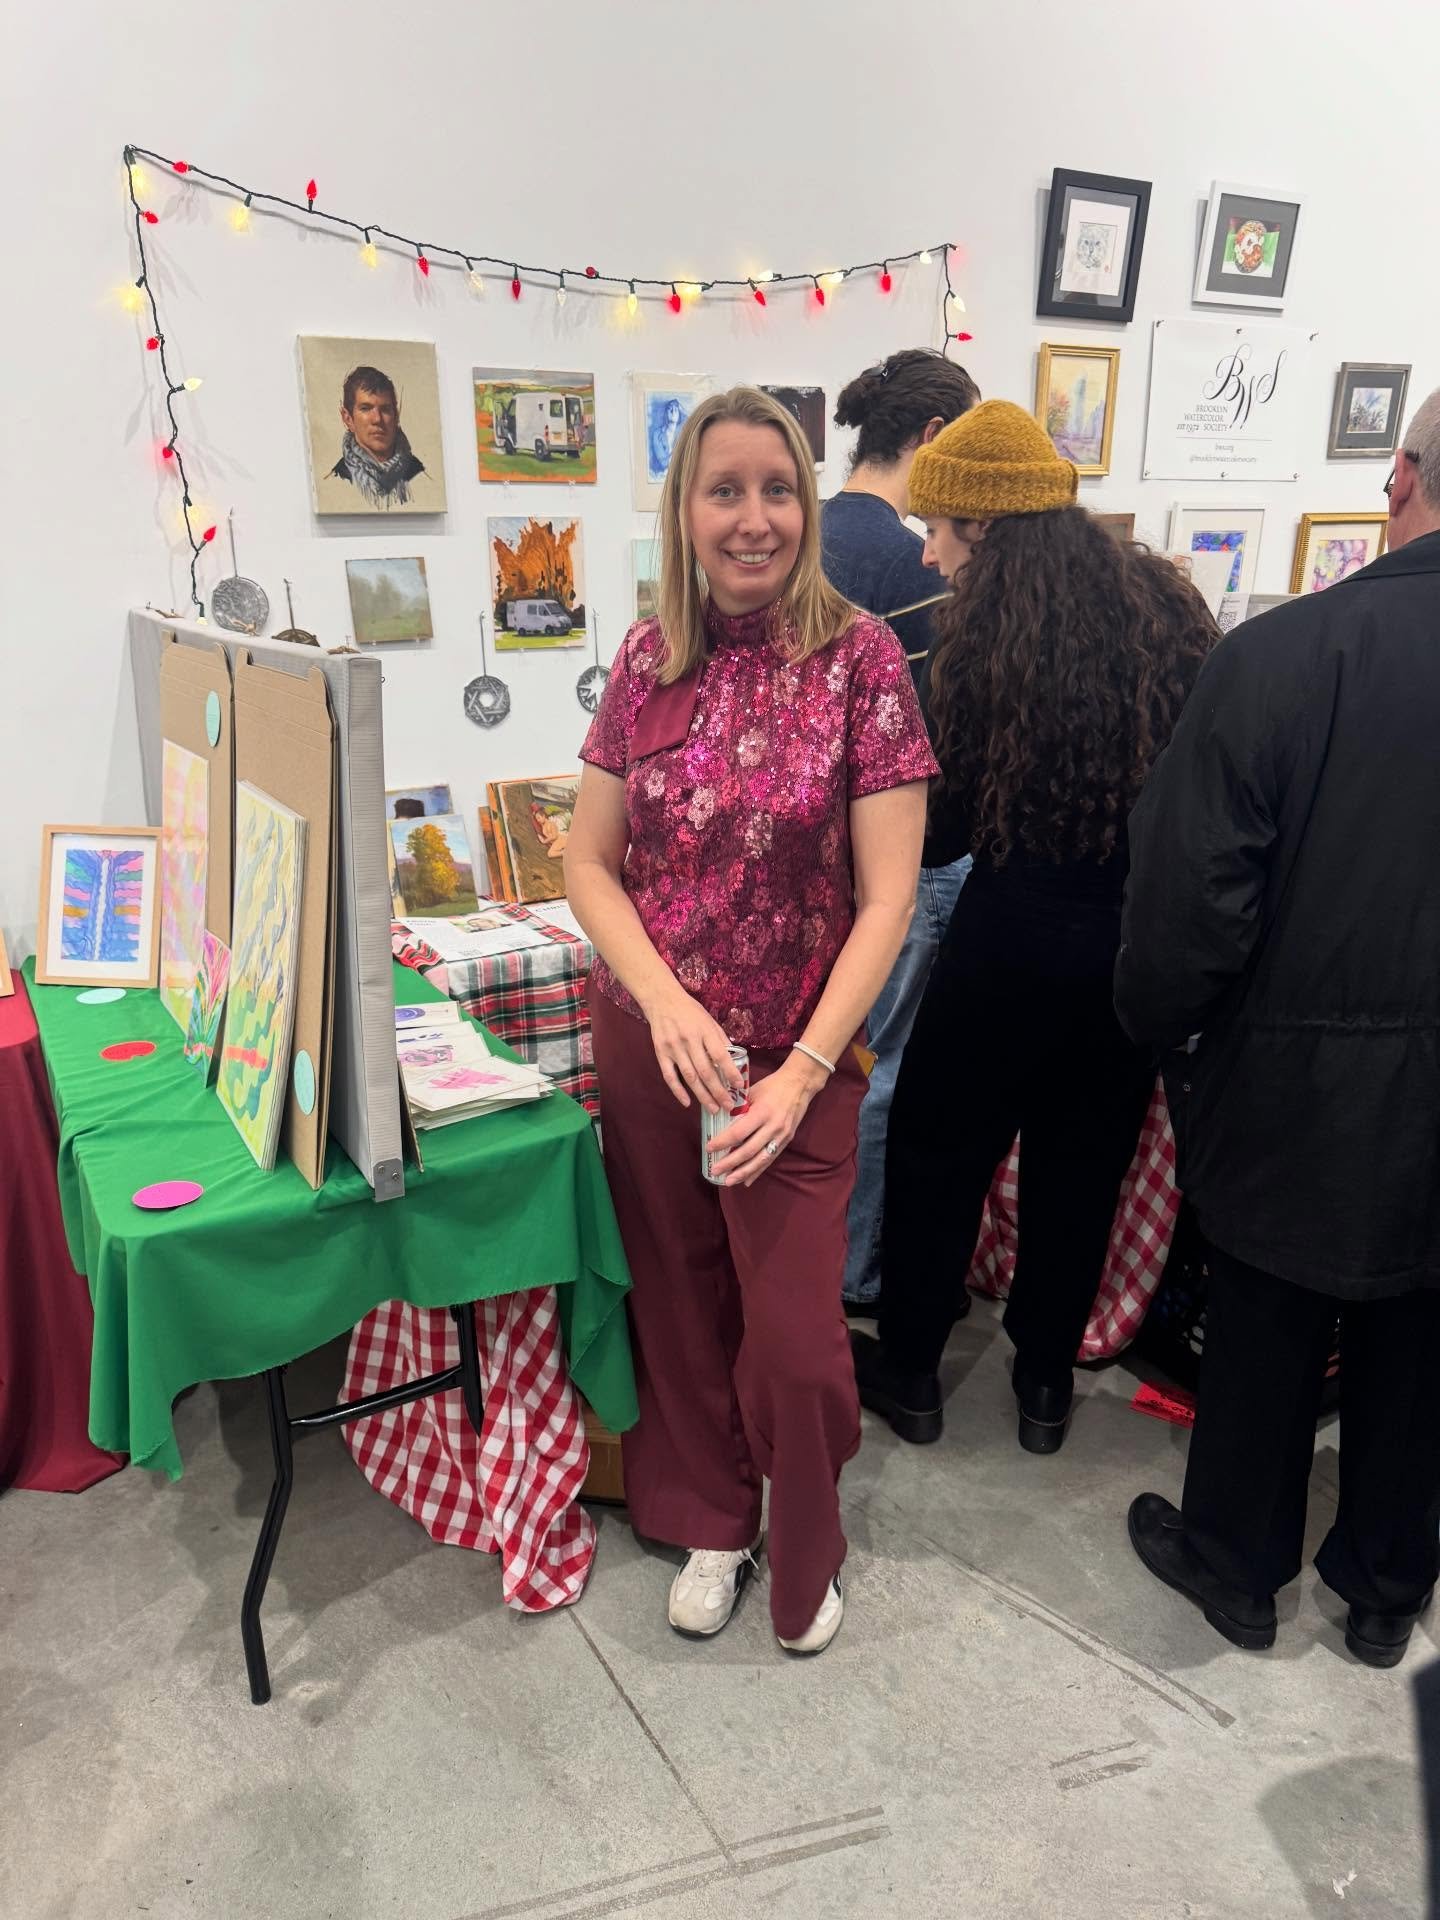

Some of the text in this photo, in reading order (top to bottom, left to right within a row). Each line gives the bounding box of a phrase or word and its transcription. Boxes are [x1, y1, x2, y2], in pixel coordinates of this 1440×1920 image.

[1195, 404, 1228, 413] BROOKLYN
[1184, 412, 1224, 422] WATERCOLOR
[1203, 423, 1229, 432] SOCIETY
